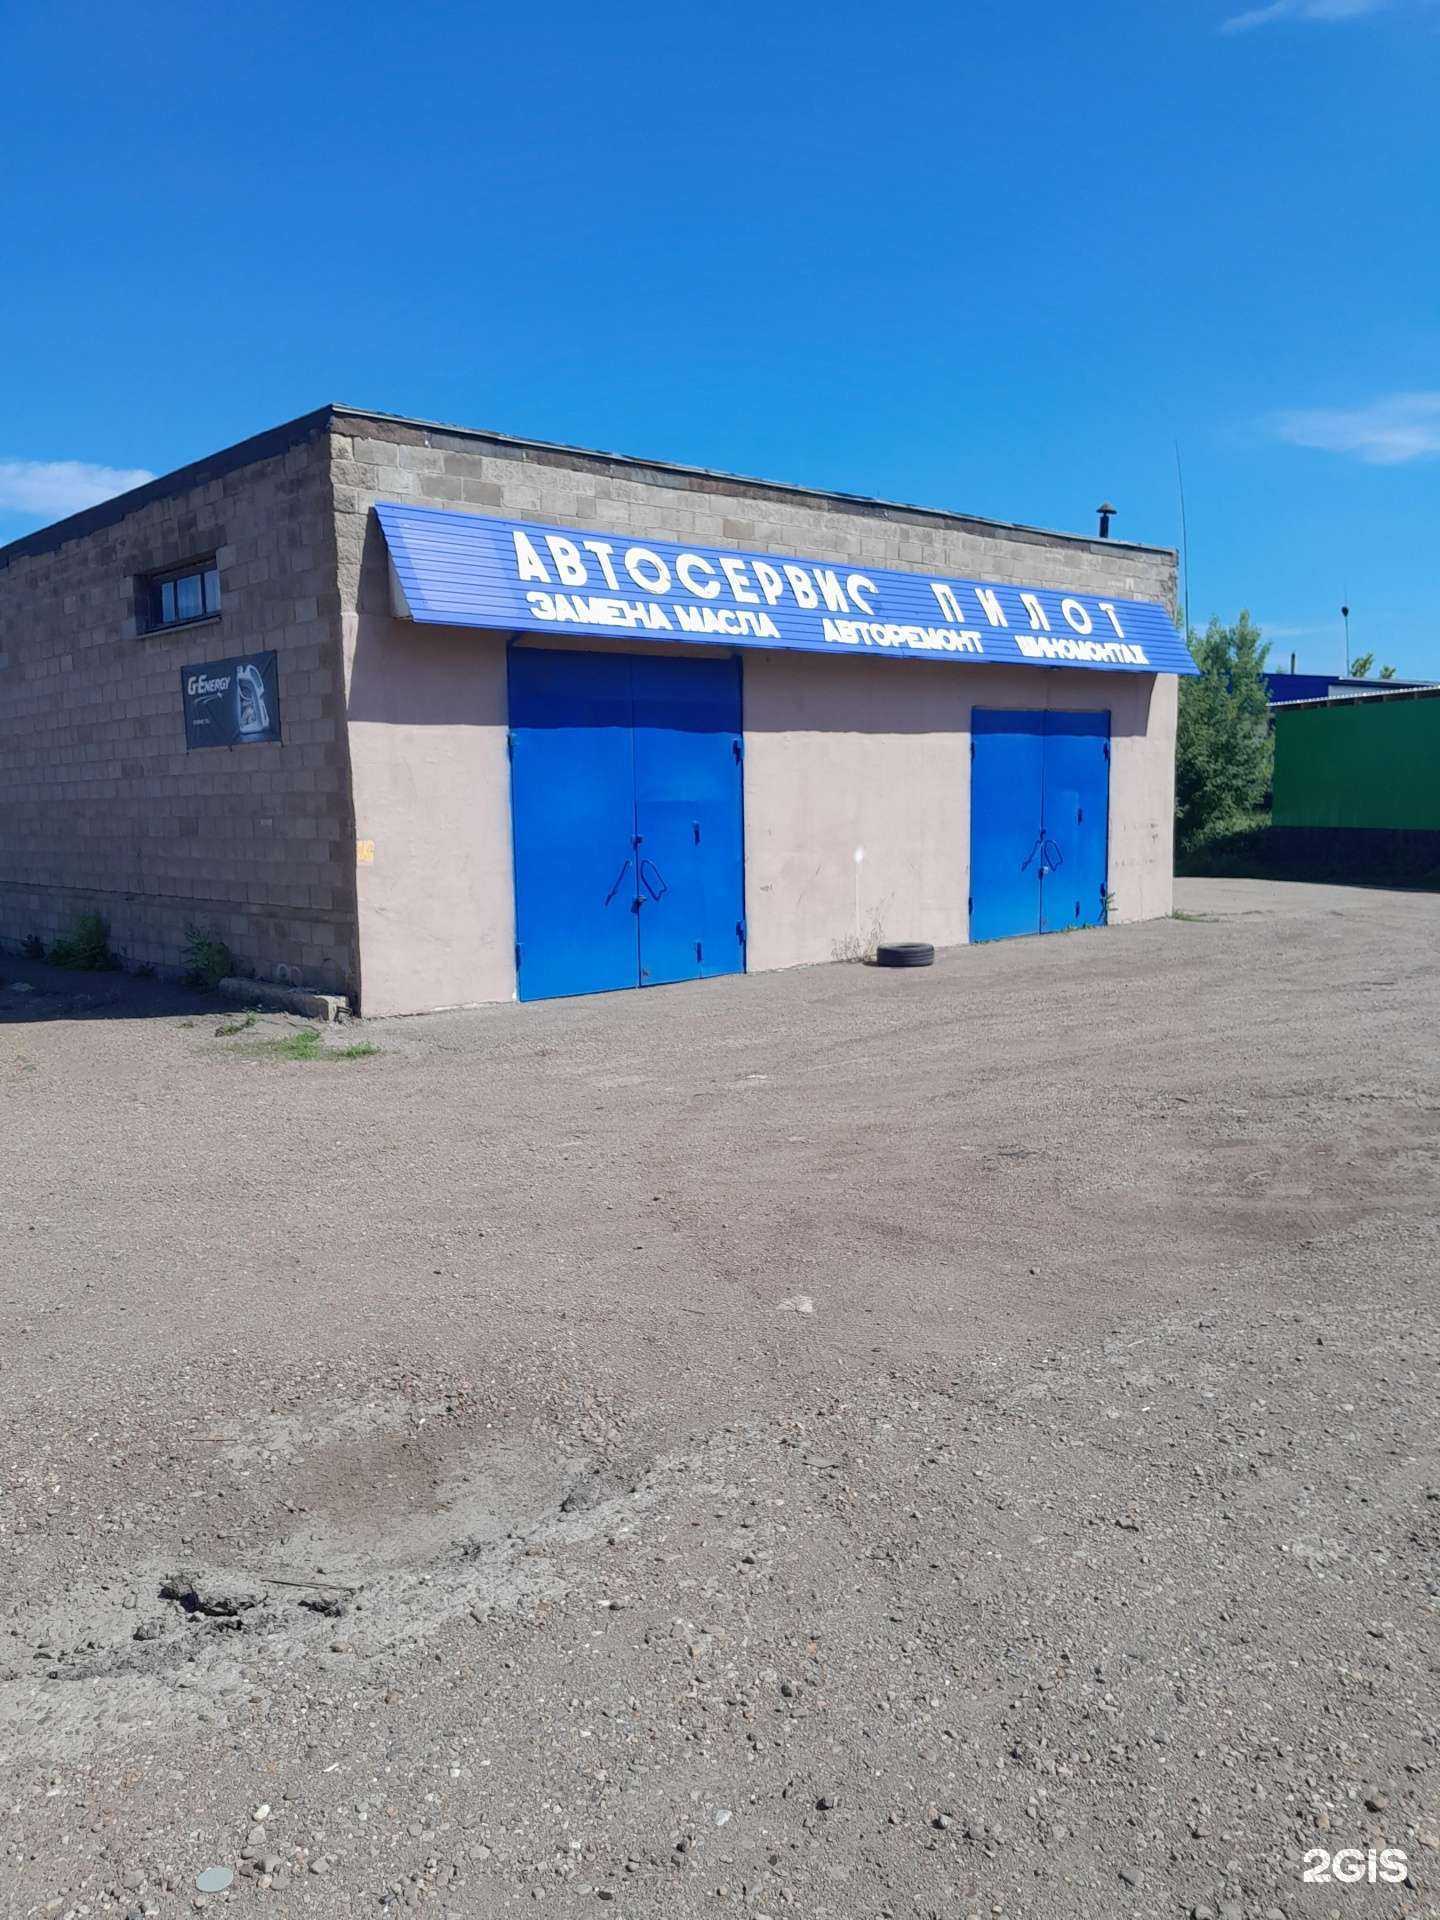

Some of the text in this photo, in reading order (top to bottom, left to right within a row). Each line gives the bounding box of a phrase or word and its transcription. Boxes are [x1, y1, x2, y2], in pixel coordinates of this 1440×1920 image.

[512, 531, 1125, 639] АВТОСЕРВИС ПИЛОТ
[526, 591, 782, 639] ЗАМЕНА МАСЛА
[822, 618, 984, 654] АВТОРЕМОНТ
[1014, 635, 1151, 665] ШИНОМОНТАЖ
